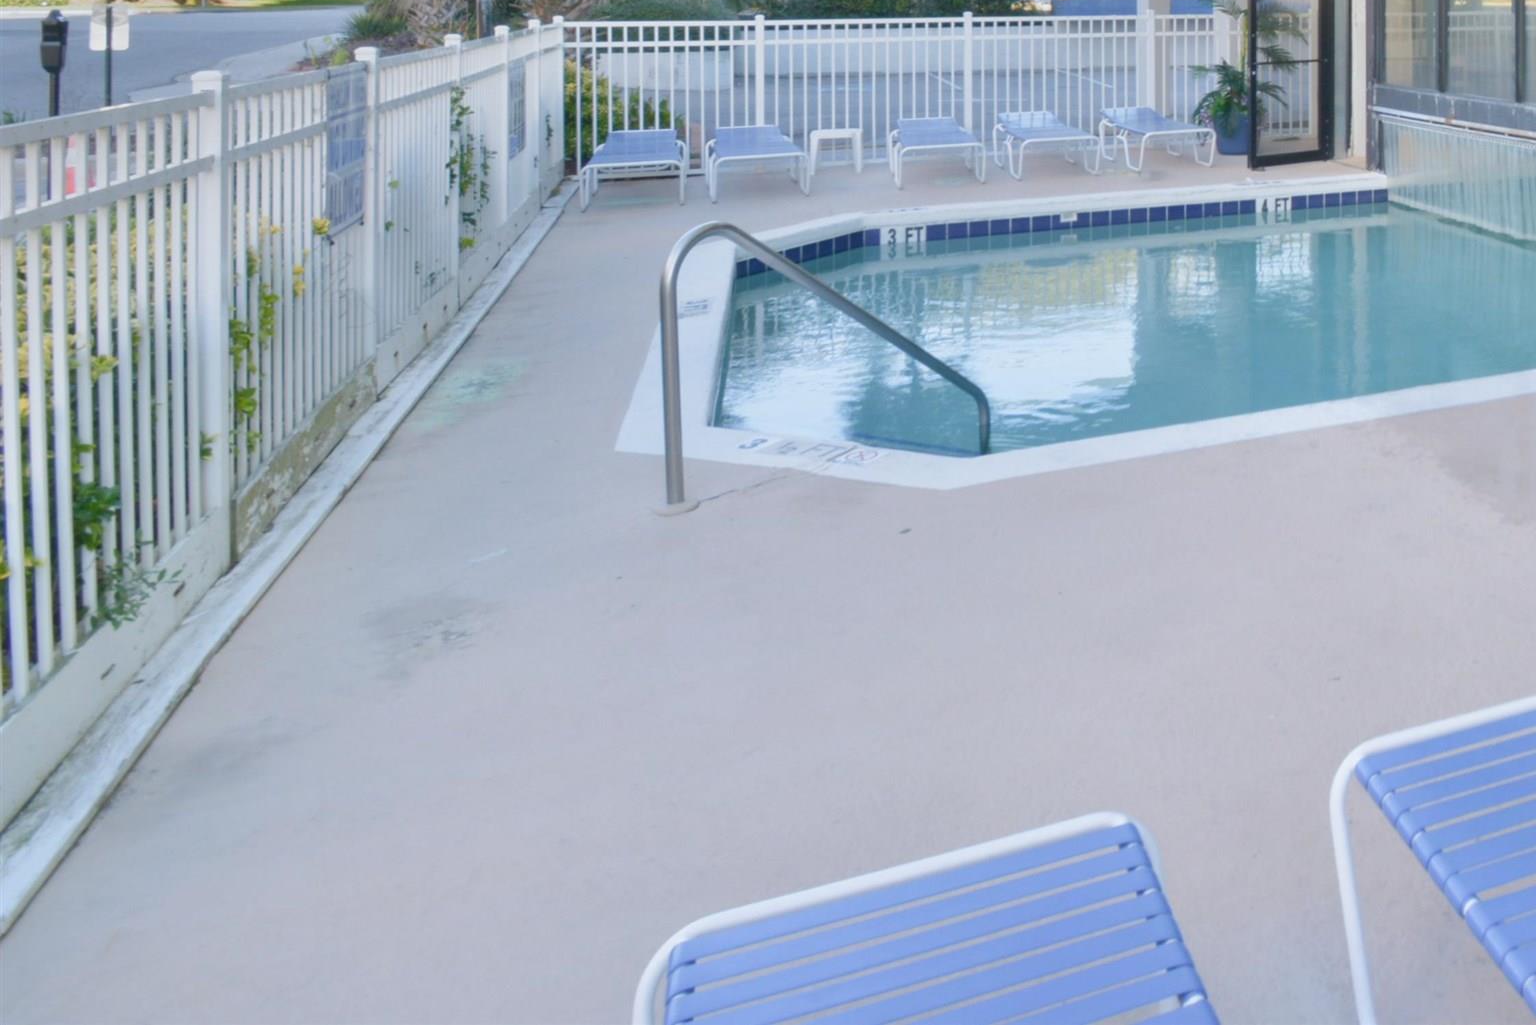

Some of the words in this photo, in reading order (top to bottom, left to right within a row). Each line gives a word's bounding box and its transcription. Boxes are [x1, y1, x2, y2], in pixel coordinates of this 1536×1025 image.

[1275, 197, 1289, 211] FT
[887, 228, 897, 246] 3
[905, 226, 924, 244] FT
